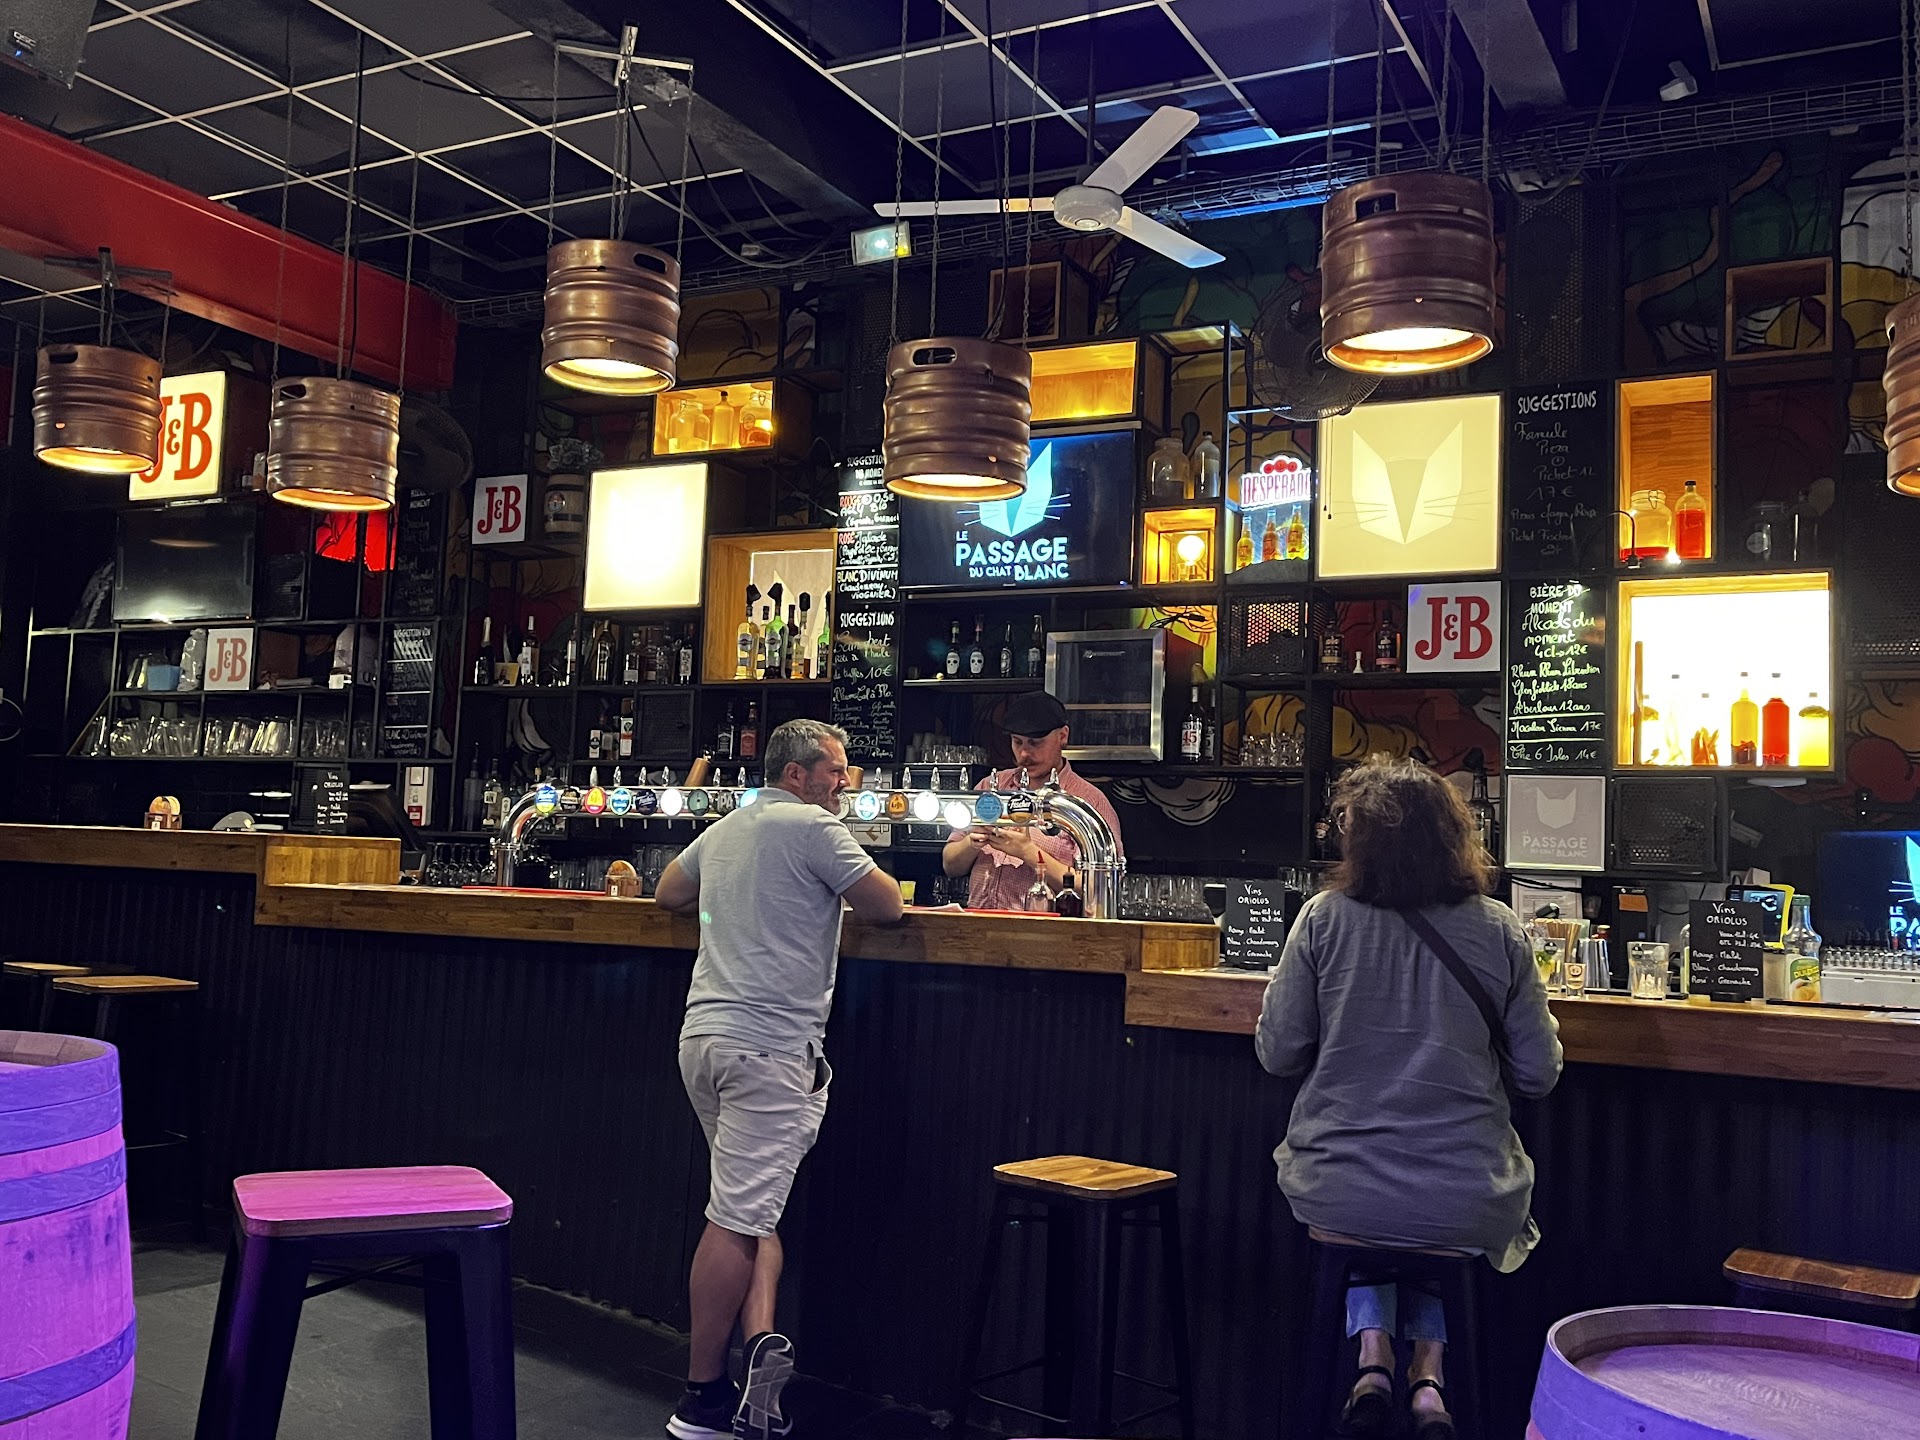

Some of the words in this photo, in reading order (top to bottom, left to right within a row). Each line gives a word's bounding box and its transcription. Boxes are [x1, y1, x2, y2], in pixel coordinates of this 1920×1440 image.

[1518, 390, 1598, 414] SUGGESTIONS
[1534, 466, 1577, 481] Pichet
[477, 485, 522, 535] J&B
[956, 530, 968, 541] LE
[955, 537, 1068, 567] PASSAGE
[969, 566, 984, 578] DU
[985, 565, 1013, 577] CHAT
[1013, 562, 1070, 581] BLANC
[1530, 601, 1574, 614] MOMENT
[1414, 596, 1493, 661] J&B
[1524, 631, 1576, 647] moment
[208, 638, 247, 682] J&B
[1183, 731, 1197, 744] 45
[1535, 747, 1543, 760] 6
[1523, 835, 1588, 849] PASSAGE
[1244, 884, 1262, 896] Vins
[1238, 896, 1270, 905] ORIOLUS
[1713, 902, 1736, 914] Vins
[1890, 905, 1904, 915] LE
[1706, 915, 1748, 926] ORIOLUS
